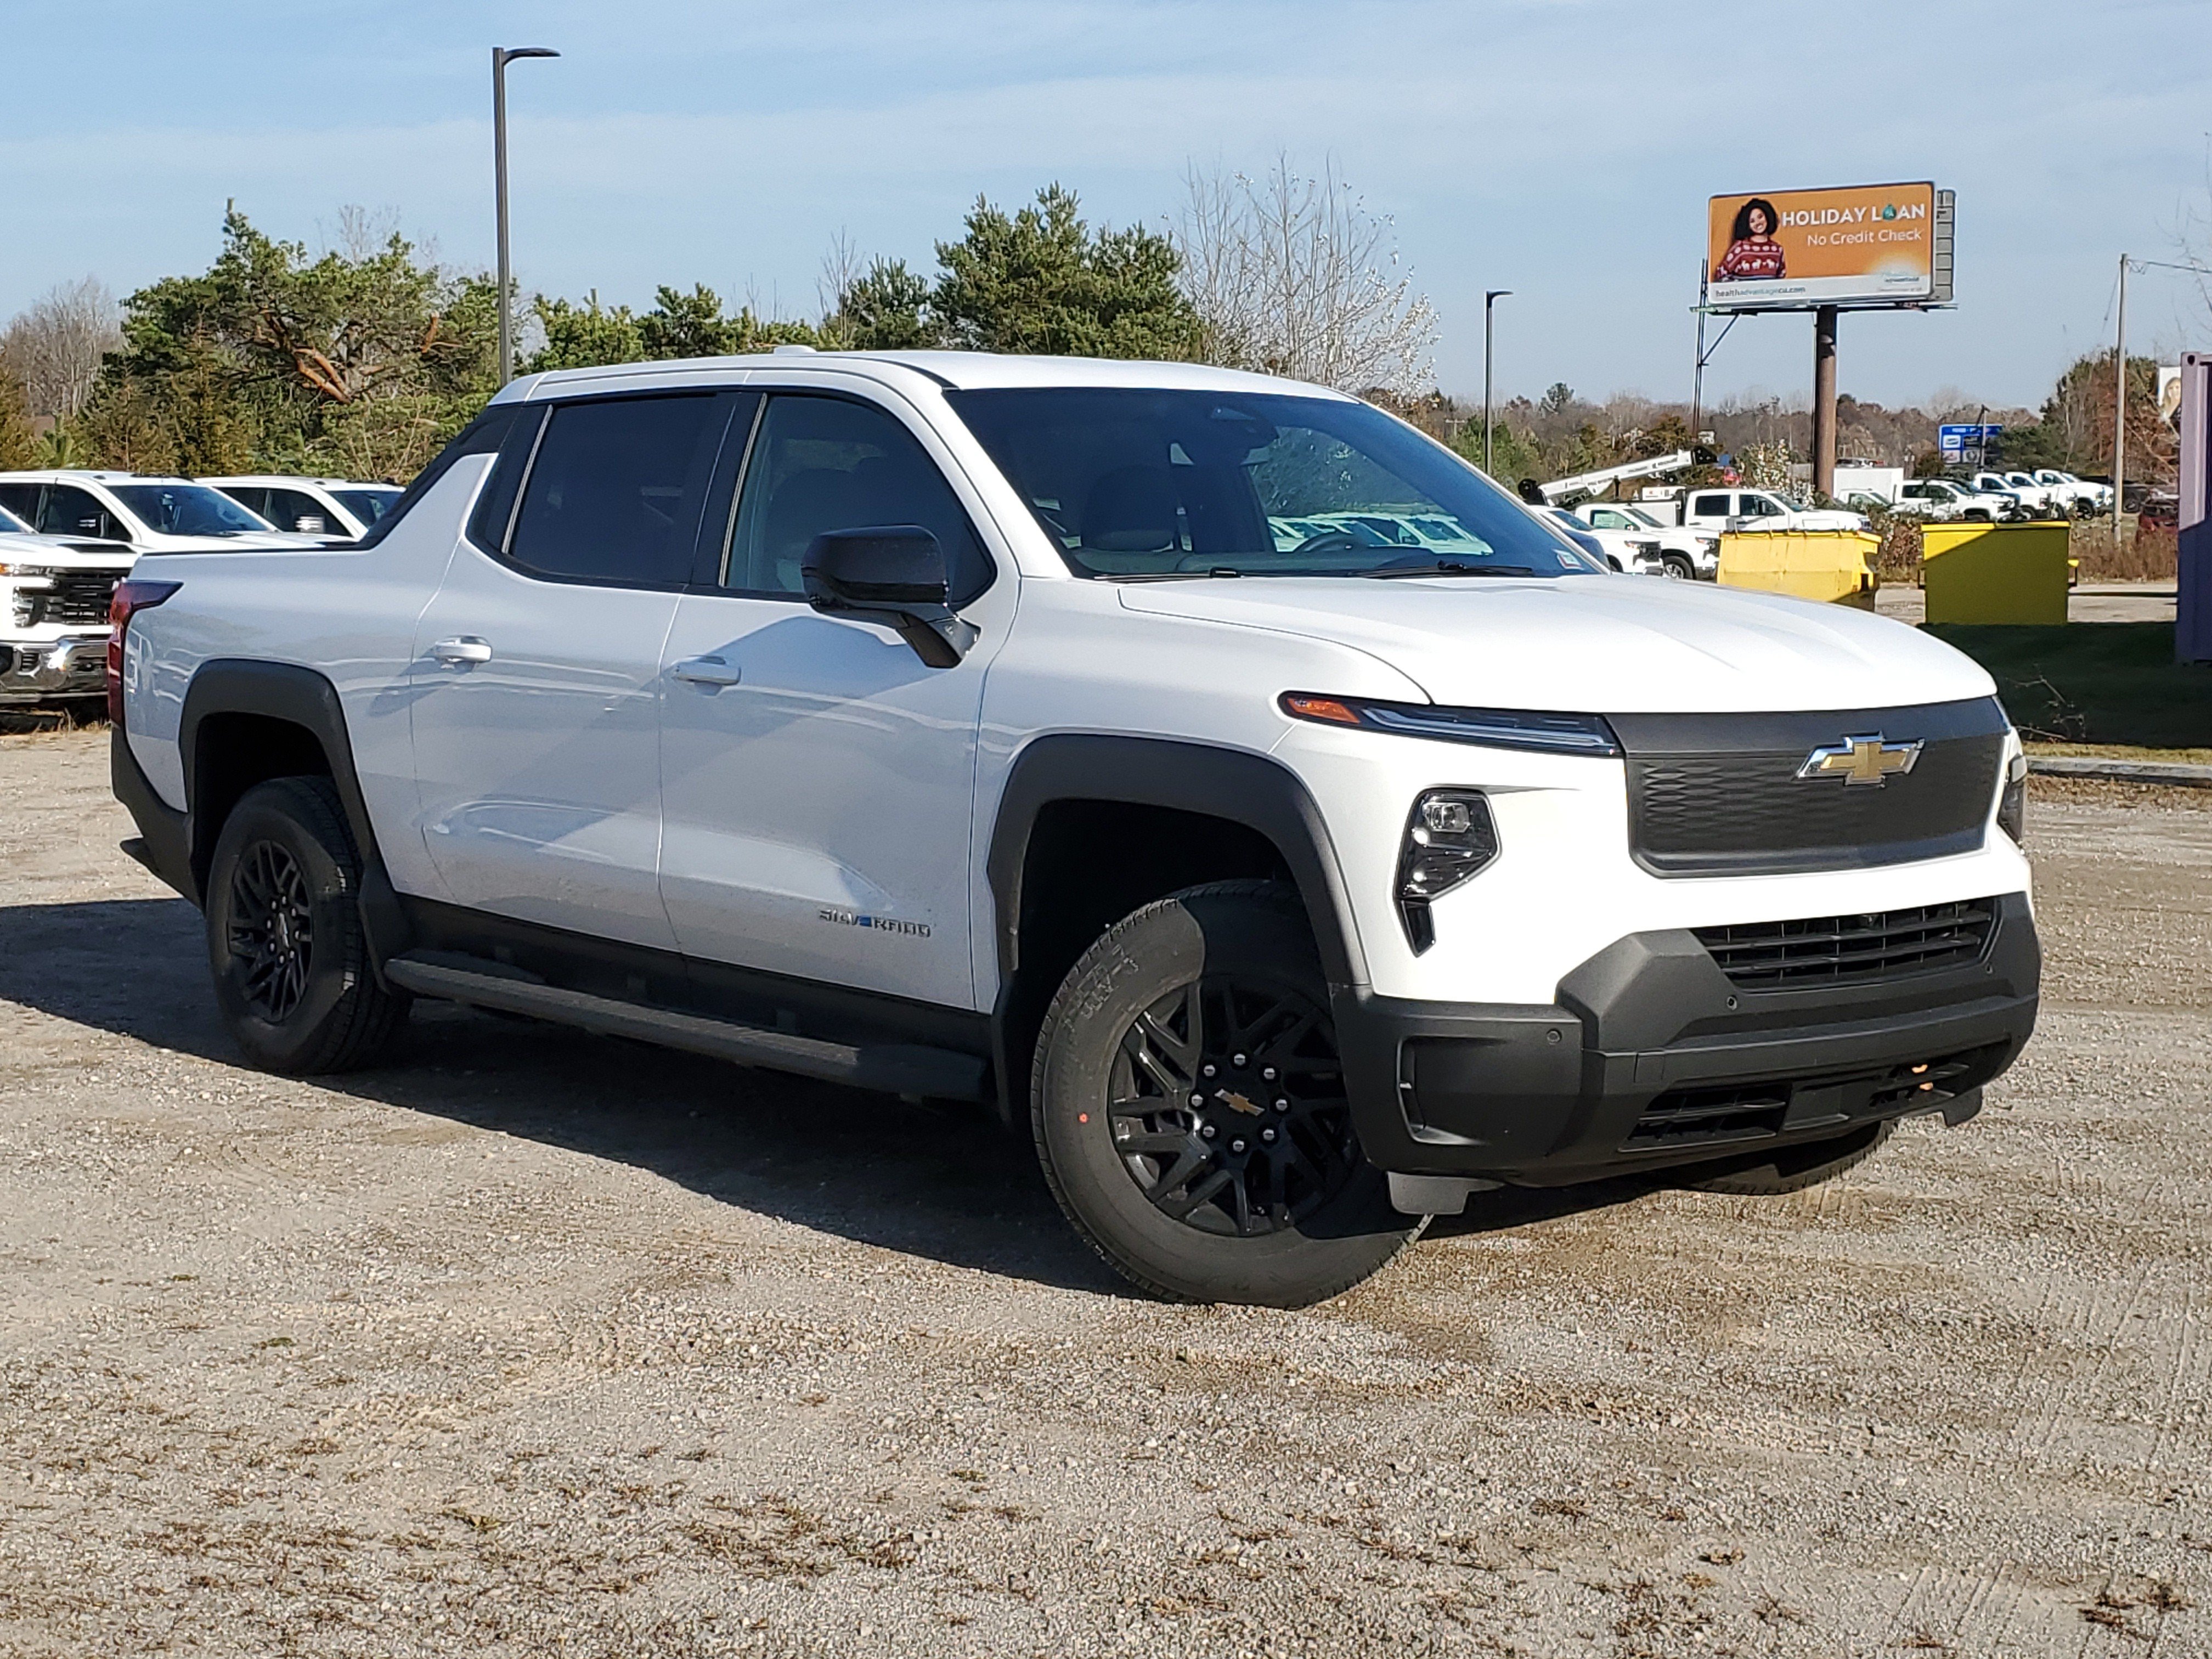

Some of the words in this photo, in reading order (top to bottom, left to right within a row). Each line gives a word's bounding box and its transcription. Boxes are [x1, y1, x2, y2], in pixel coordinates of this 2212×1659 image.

[1782, 206, 1867, 227] HOLIDAY
[1872, 203, 1926, 222] LOAN
[1807, 234, 1827, 247] No
[1830, 230, 1875, 245] Credit
[1878, 227, 1922, 242] Check
[820, 909, 932, 938] SILVERADO
